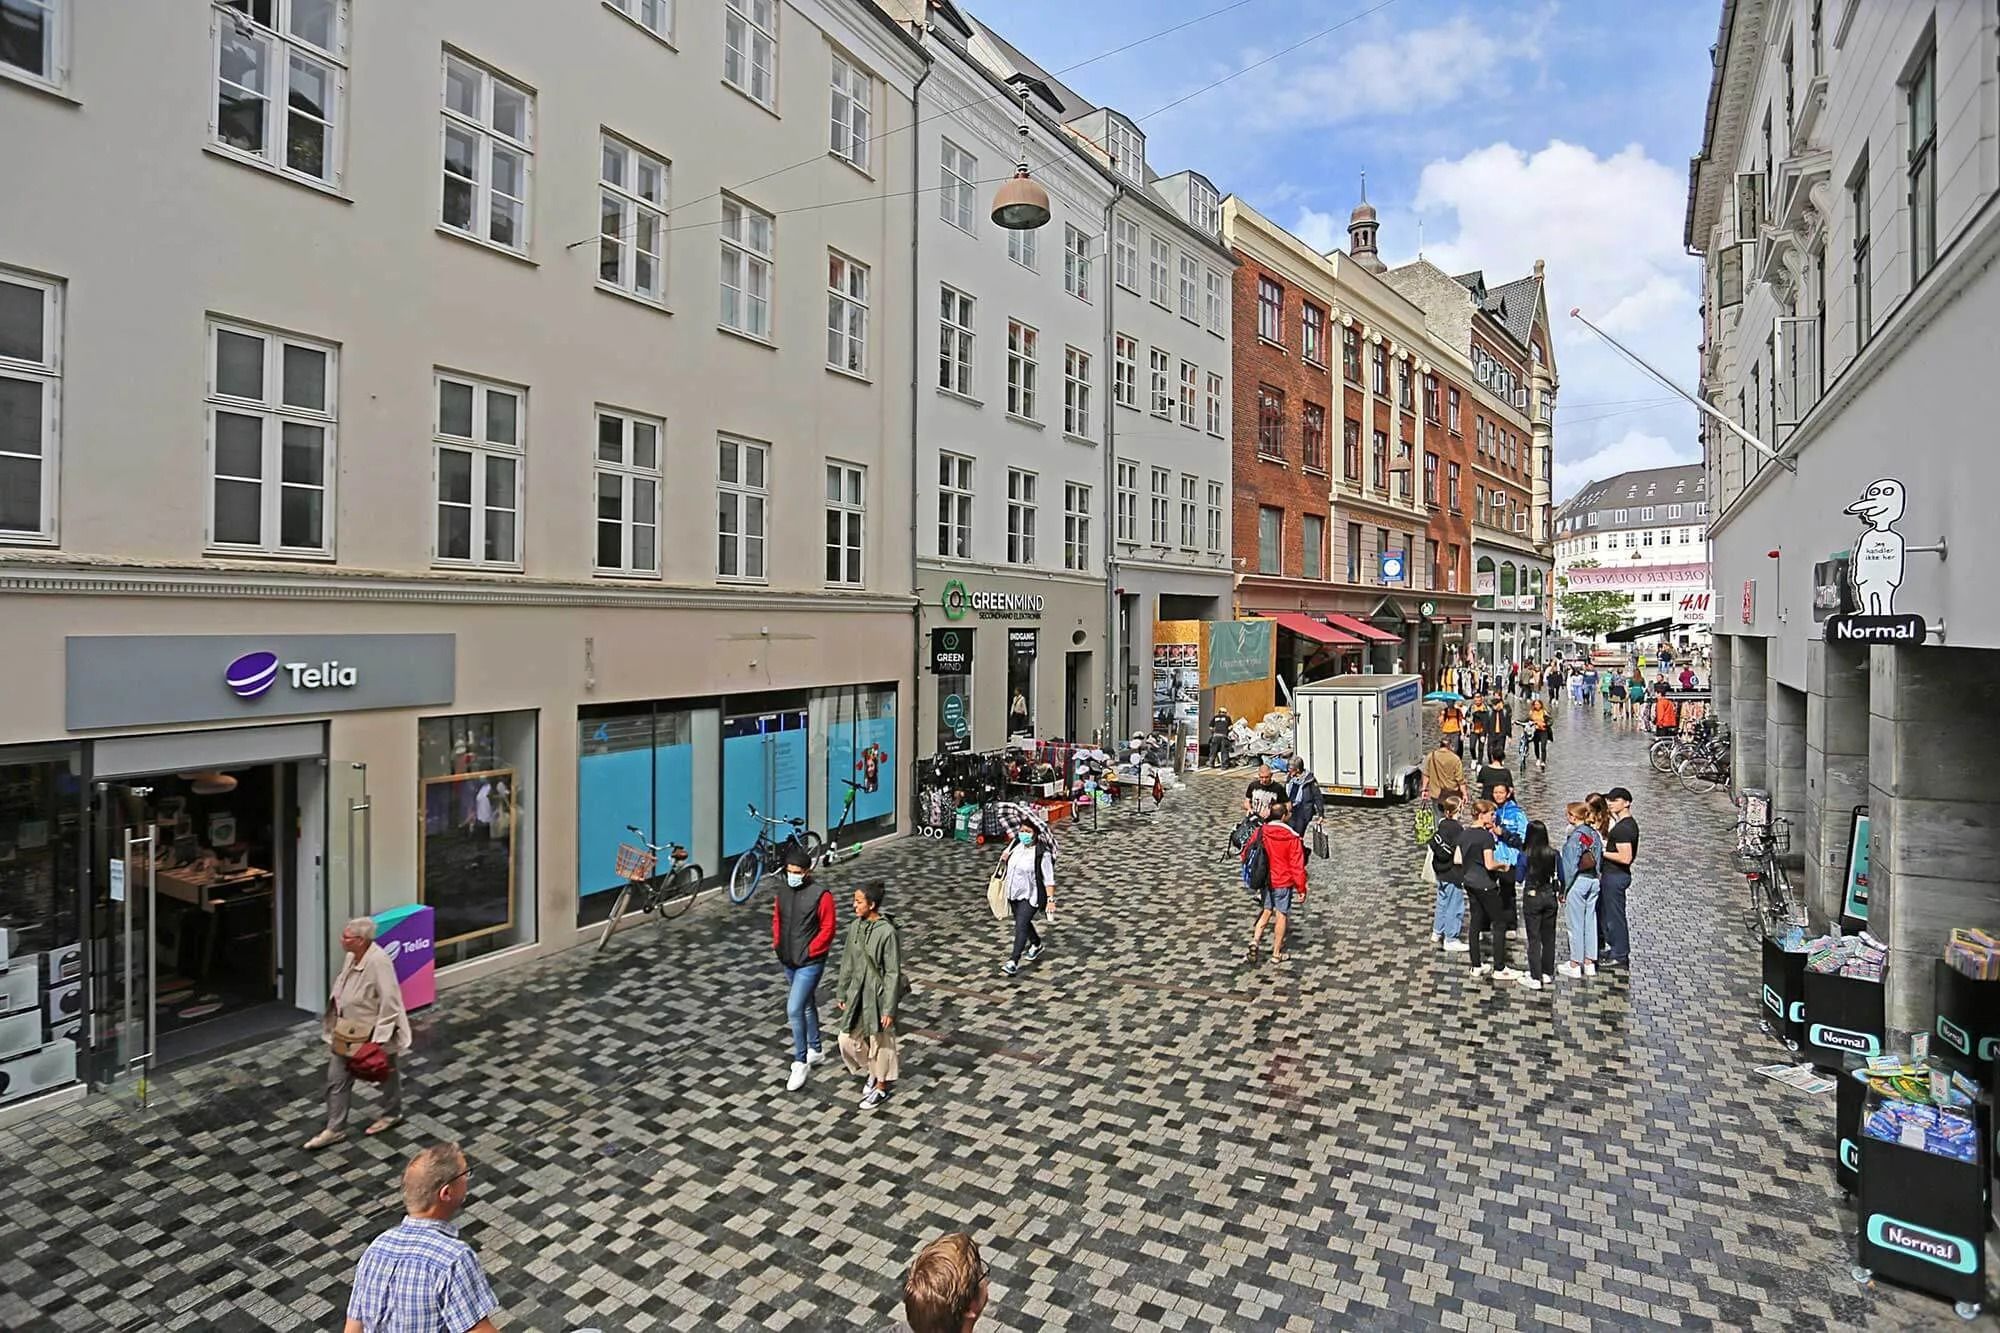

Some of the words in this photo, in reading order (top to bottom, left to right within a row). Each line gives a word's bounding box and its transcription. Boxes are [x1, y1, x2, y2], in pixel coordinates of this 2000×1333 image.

[972, 592, 1045, 611] GREENMIND
[1679, 593, 1711, 612] H&M
[1683, 612, 1705, 621] KIDS
[1837, 619, 1915, 639] Normal
[936, 653, 965, 662] GREEN
[939, 662, 962, 671] MIND
[284, 661, 357, 689] Telia
[402, 938, 430, 953] Telia
[1823, 1031, 1865, 1049] Normal
[1888, 1227, 1953, 1260] Normal
